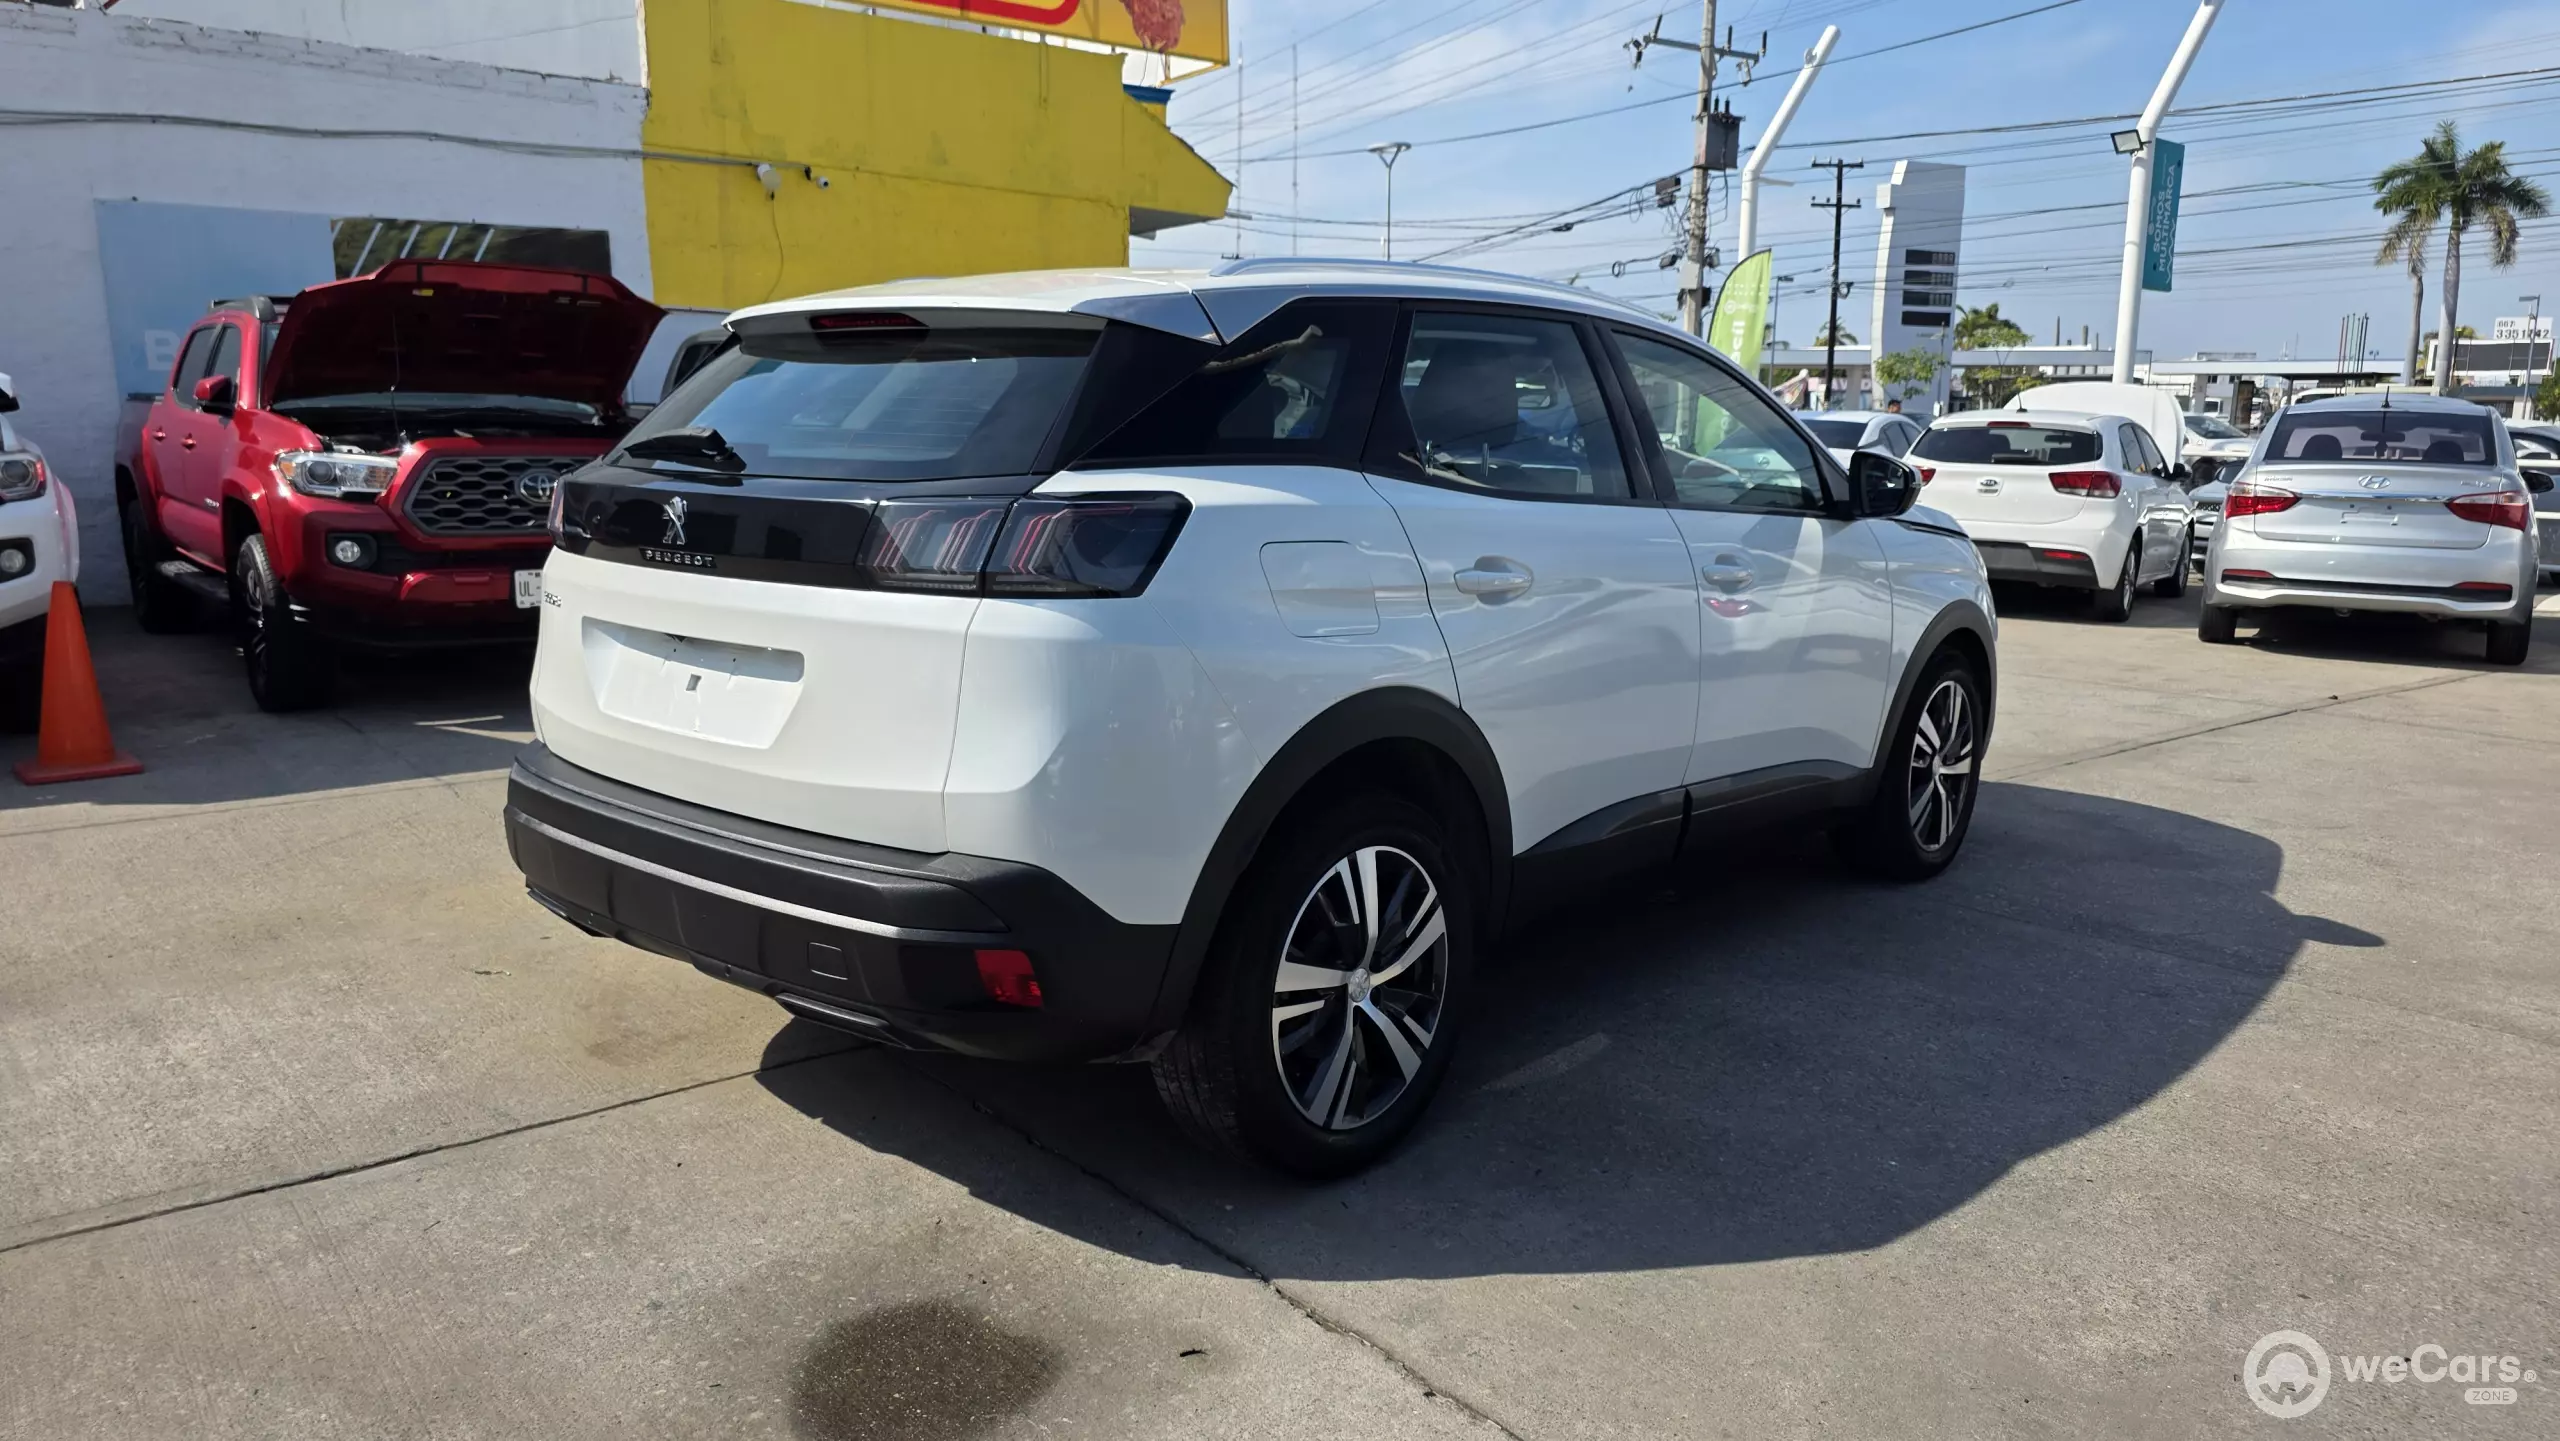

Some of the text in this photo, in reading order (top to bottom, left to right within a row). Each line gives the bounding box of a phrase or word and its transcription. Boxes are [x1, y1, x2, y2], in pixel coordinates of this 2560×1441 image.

[2153, 191, 2165, 253] SOMOS
[2158, 164, 2176, 272] MULTIMARCA
[644, 549, 713, 567] PEUGEOT
